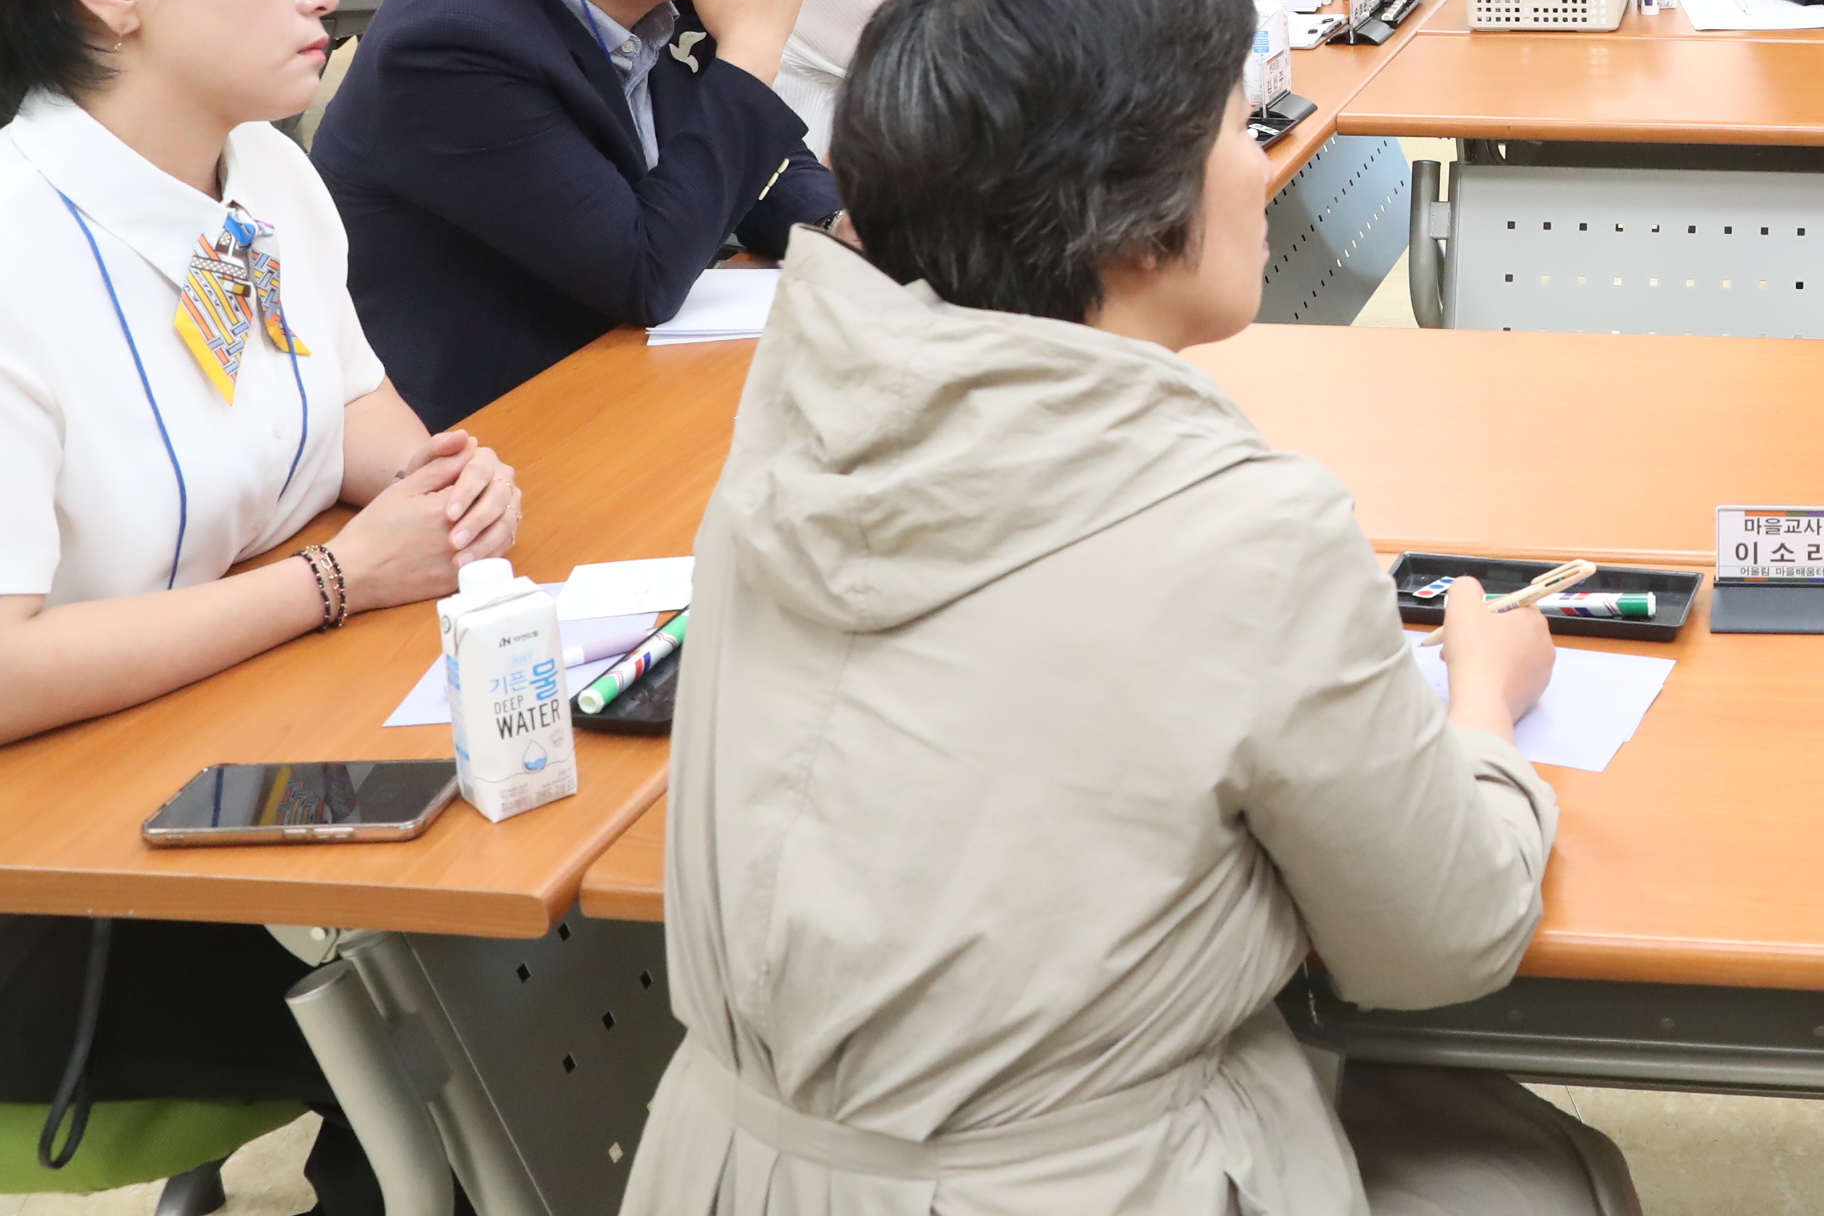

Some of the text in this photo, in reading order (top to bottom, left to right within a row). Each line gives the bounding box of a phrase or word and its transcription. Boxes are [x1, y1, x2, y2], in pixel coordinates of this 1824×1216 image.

[1744, 517, 1823, 536] 마을교사
[1740, 567, 1770, 577] 어울림
[489, 658, 559, 702] 기픈 물
[493, 695, 524, 715] DEEP
[496, 698, 562, 740] WATER
